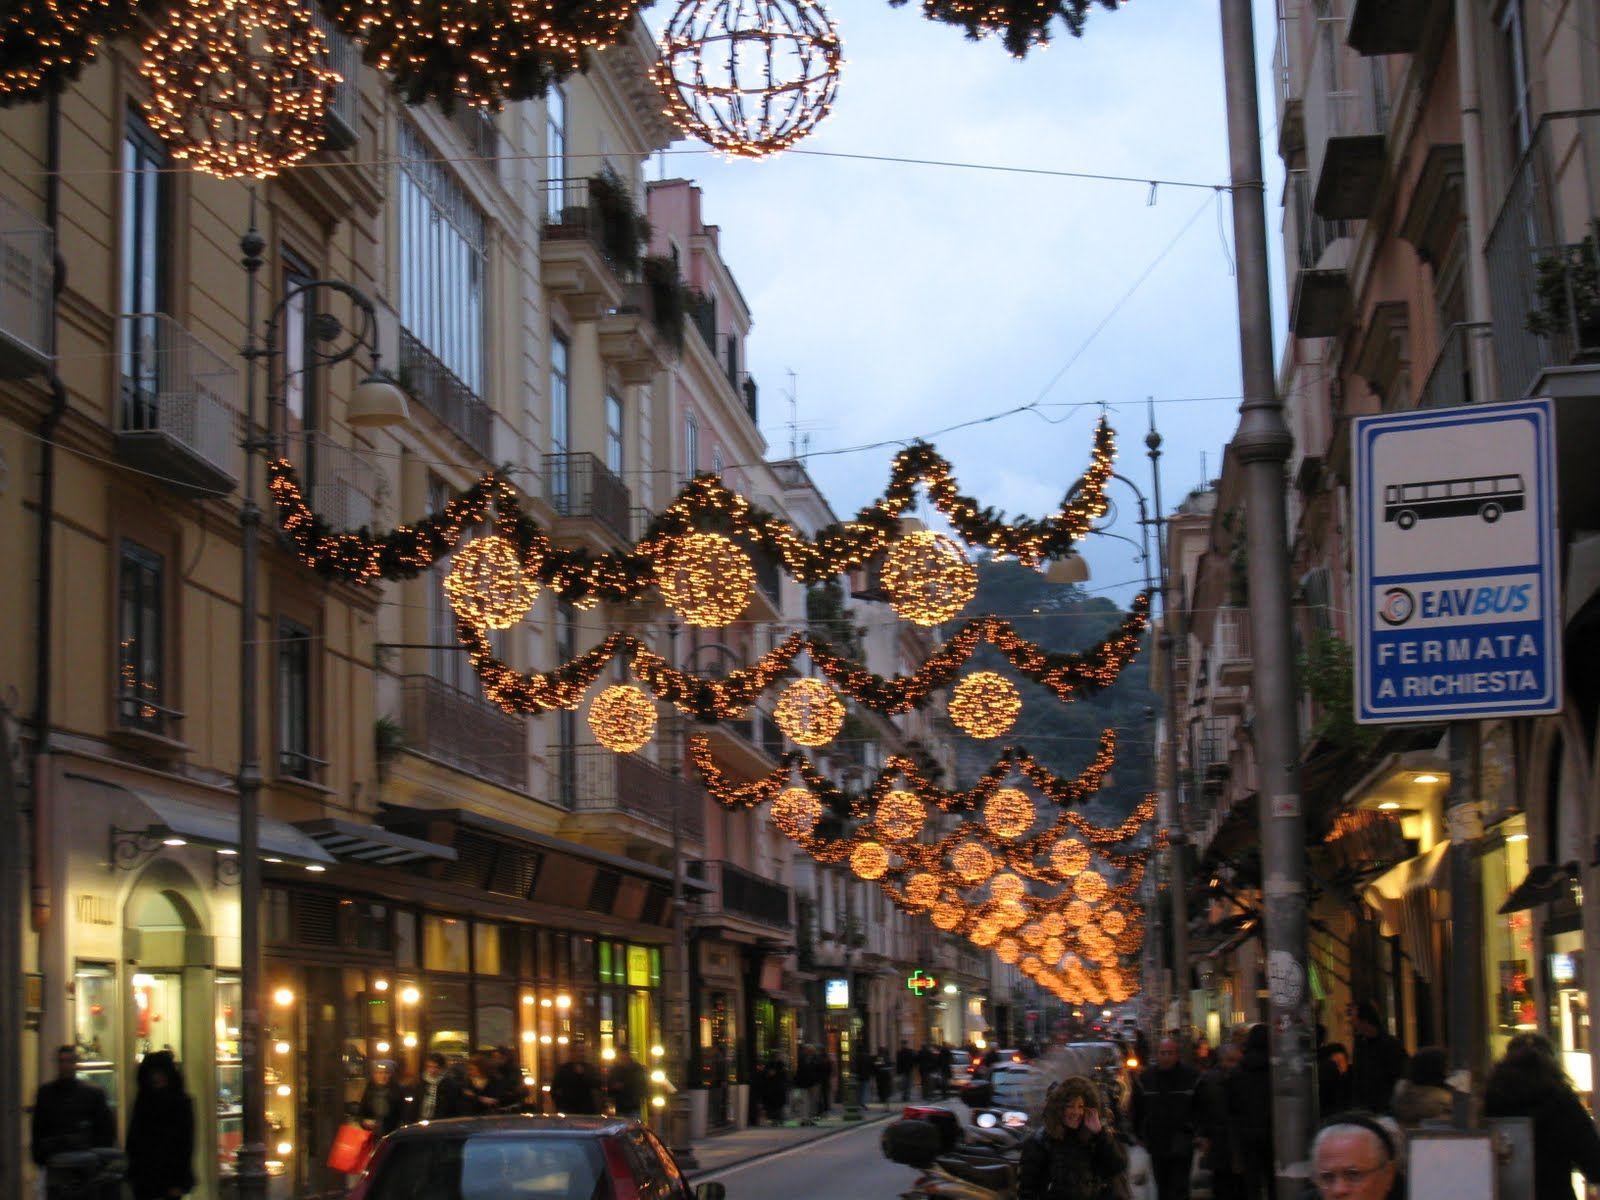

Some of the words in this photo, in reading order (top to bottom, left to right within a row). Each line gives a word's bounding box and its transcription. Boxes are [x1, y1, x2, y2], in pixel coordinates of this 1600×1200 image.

[1421, 584, 1533, 618] EAVBUS
[1377, 634, 1538, 666] FERMATA
[1376, 678, 1397, 699] A
[1402, 669, 1539, 697] RICHIESTA
